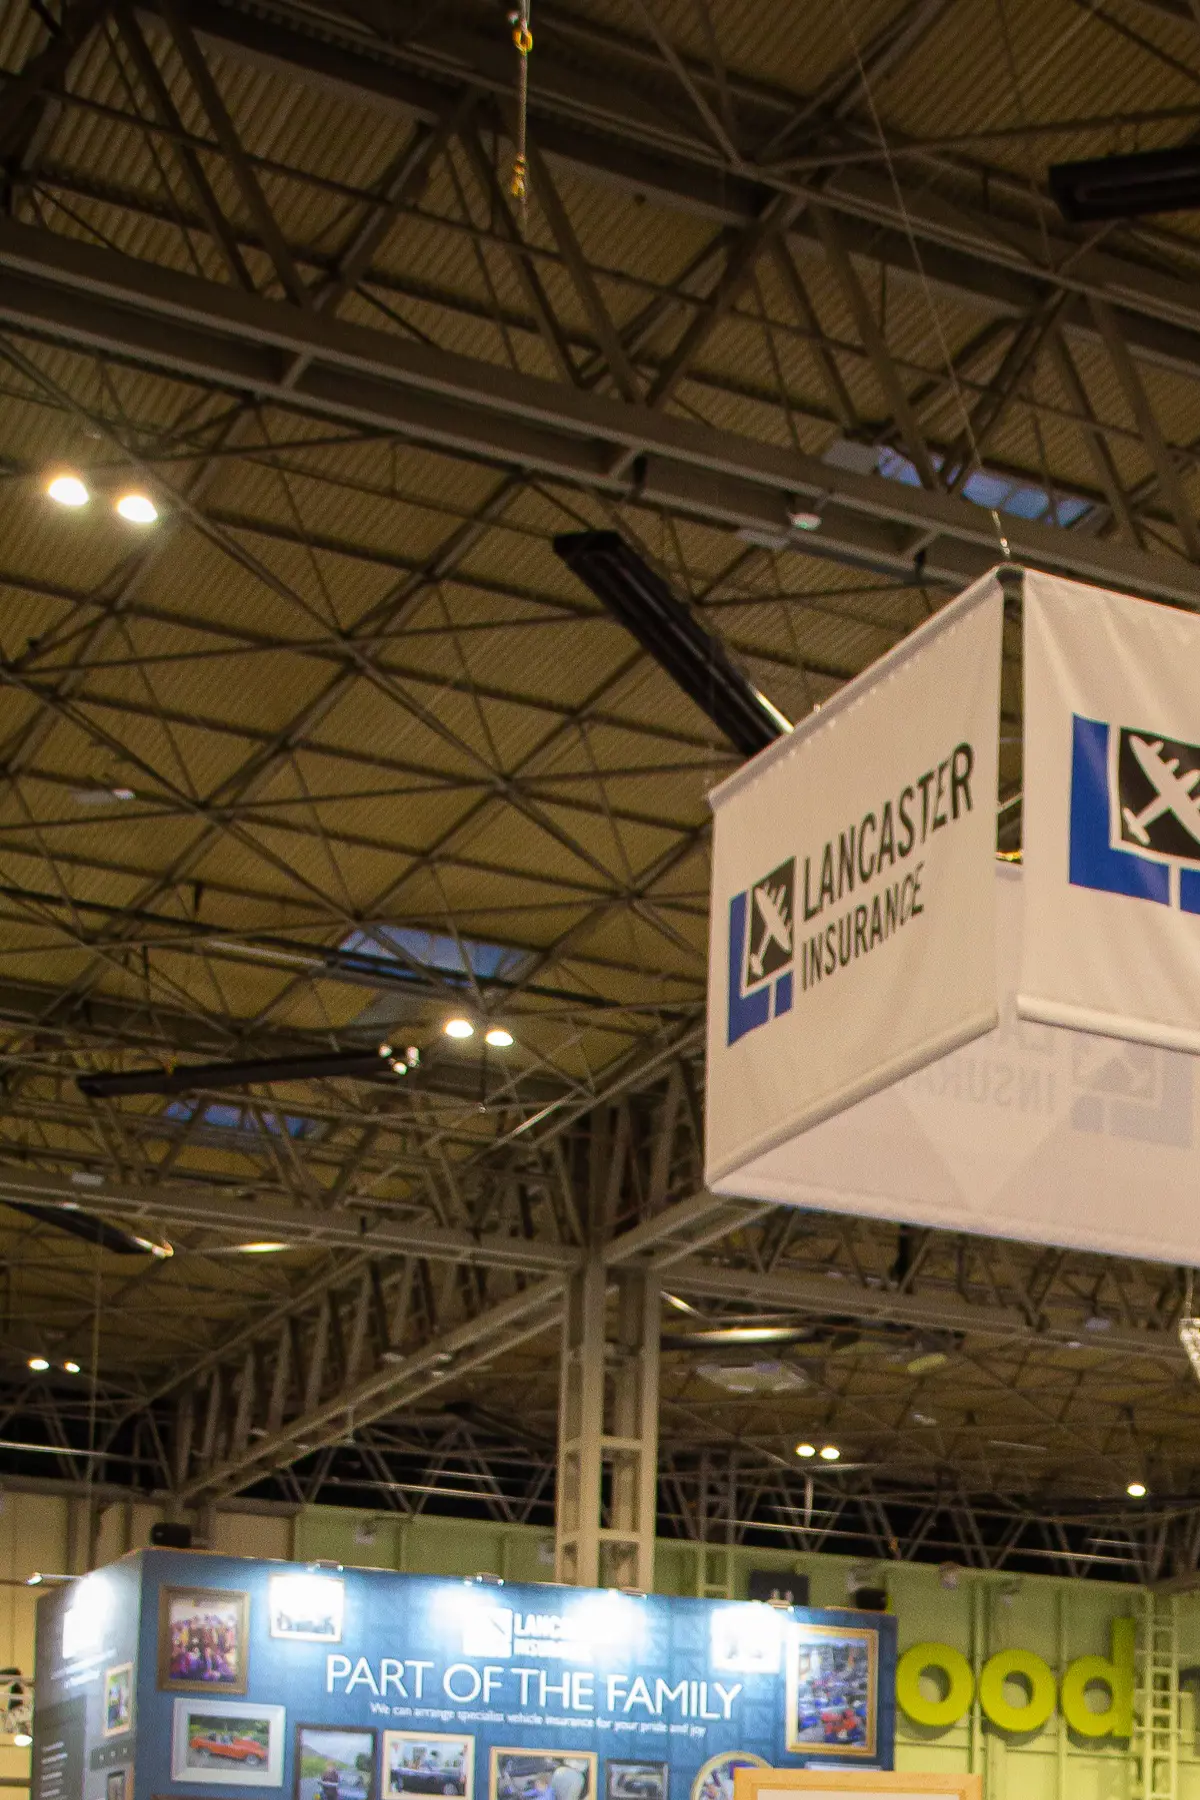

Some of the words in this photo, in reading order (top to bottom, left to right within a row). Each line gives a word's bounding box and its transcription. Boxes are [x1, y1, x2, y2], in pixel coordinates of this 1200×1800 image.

[803, 742, 973, 922] LANCASTER
[801, 861, 925, 991] INSURANCE
[325, 1653, 434, 1698] PART
[443, 1662, 503, 1704] OF
[511, 1667, 595, 1712] THE
[606, 1674, 743, 1720] FAMILY
[370, 1702, 390, 1715] We
[392, 1706, 412, 1716] can
[414, 1707, 455, 1722] arrange
[456, 1710, 504, 1723] specialist
[506, 1712, 543, 1725] vehicle
[545, 1714, 594, 1728] insurance
[596, 1717, 612, 1729] for
[613, 1721, 638, 1733] your
[640, 1721, 668, 1734] pride
[670, 1722, 689, 1734] and
[690, 1723, 707, 1738] joy
[896, 1617, 1134, 1738] ood
